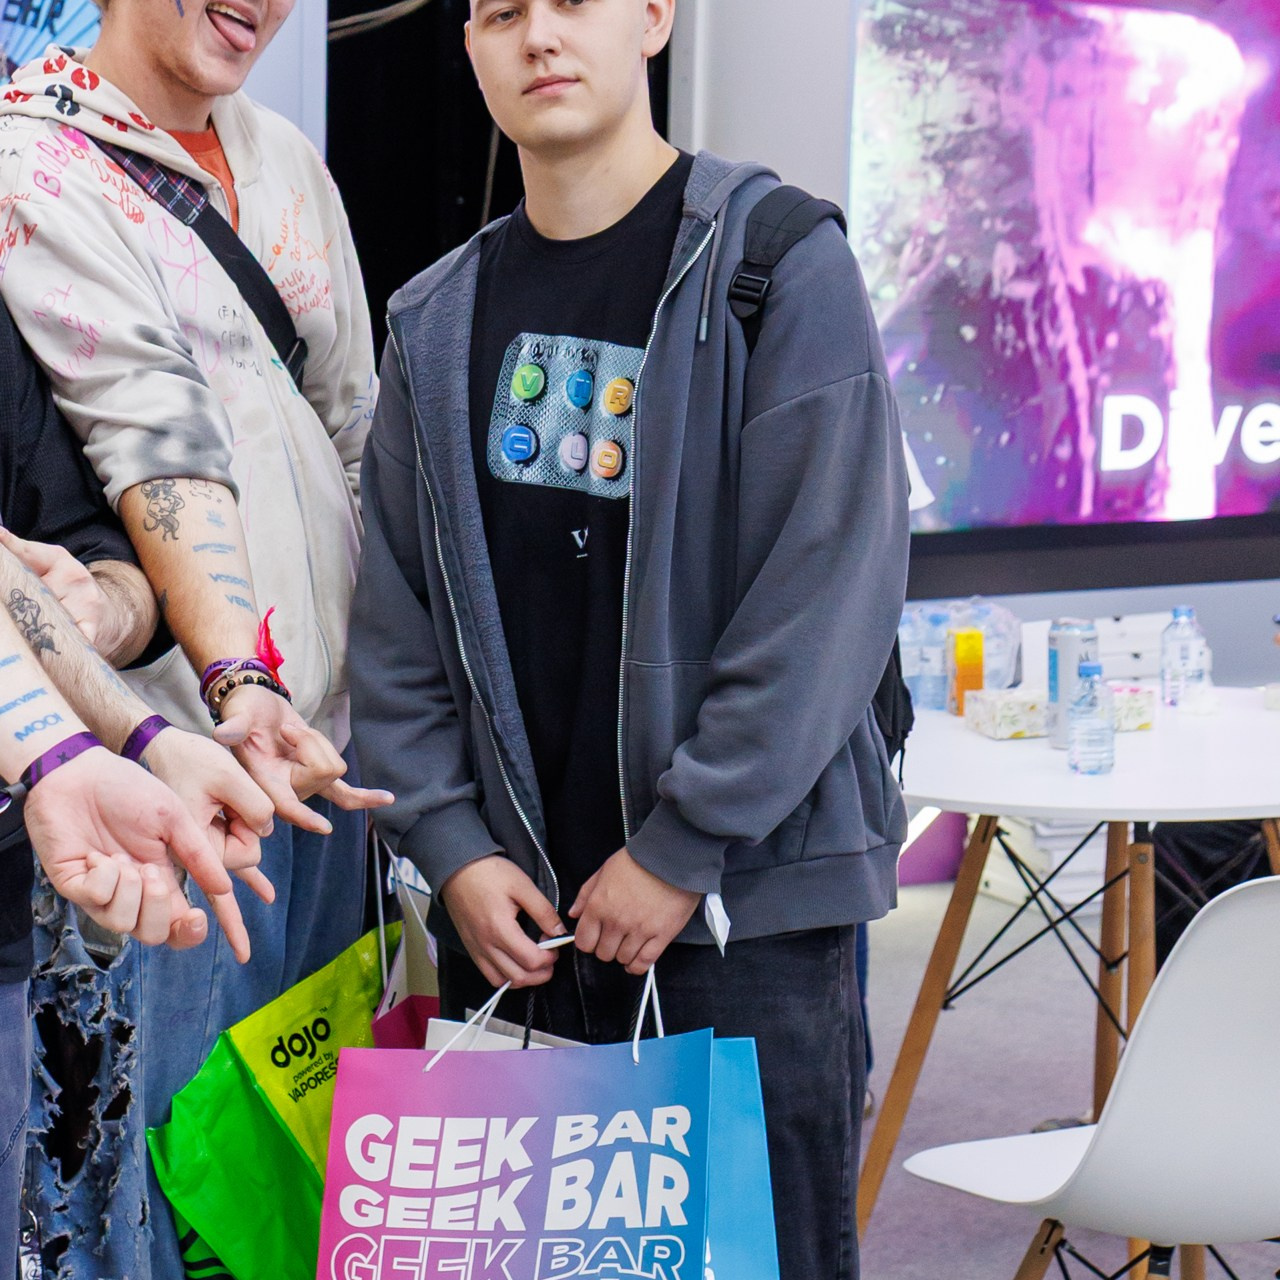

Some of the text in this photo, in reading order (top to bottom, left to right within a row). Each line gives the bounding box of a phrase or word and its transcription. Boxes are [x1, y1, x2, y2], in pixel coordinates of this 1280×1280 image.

[14, 711, 65, 742] MOOI
[270, 1016, 331, 1069] dojo
[292, 1049, 334, 1084] powered by
[344, 1105, 692, 1190] GEEK BAR
[338, 1150, 691, 1232] GEEK BAR
